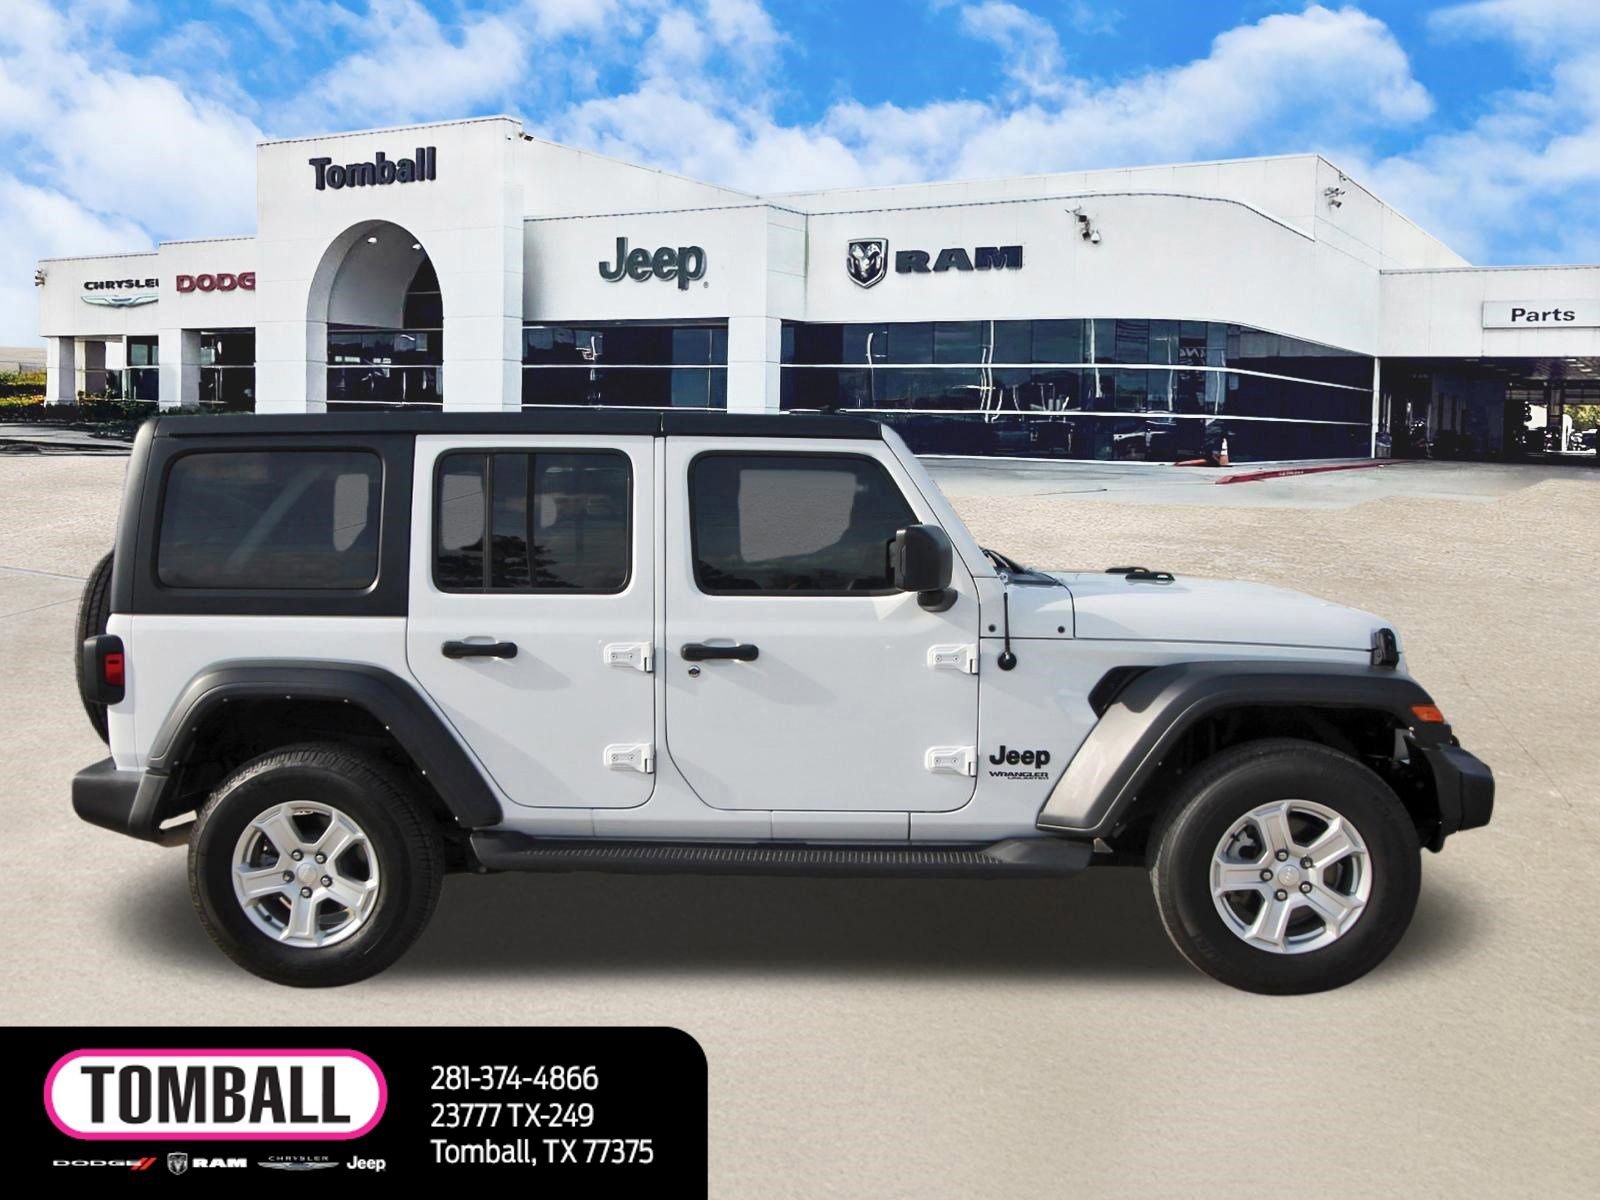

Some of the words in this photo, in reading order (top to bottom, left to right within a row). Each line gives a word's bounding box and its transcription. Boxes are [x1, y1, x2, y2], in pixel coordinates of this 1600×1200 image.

[308, 146, 437, 190] Tomball
[599, 237, 707, 290] Jeep
[895, 245, 1023, 275] RAM
[176, 272, 256, 294] DODG
[1511, 307, 1576, 322] Parts
[988, 744, 1051, 769] Jeep
